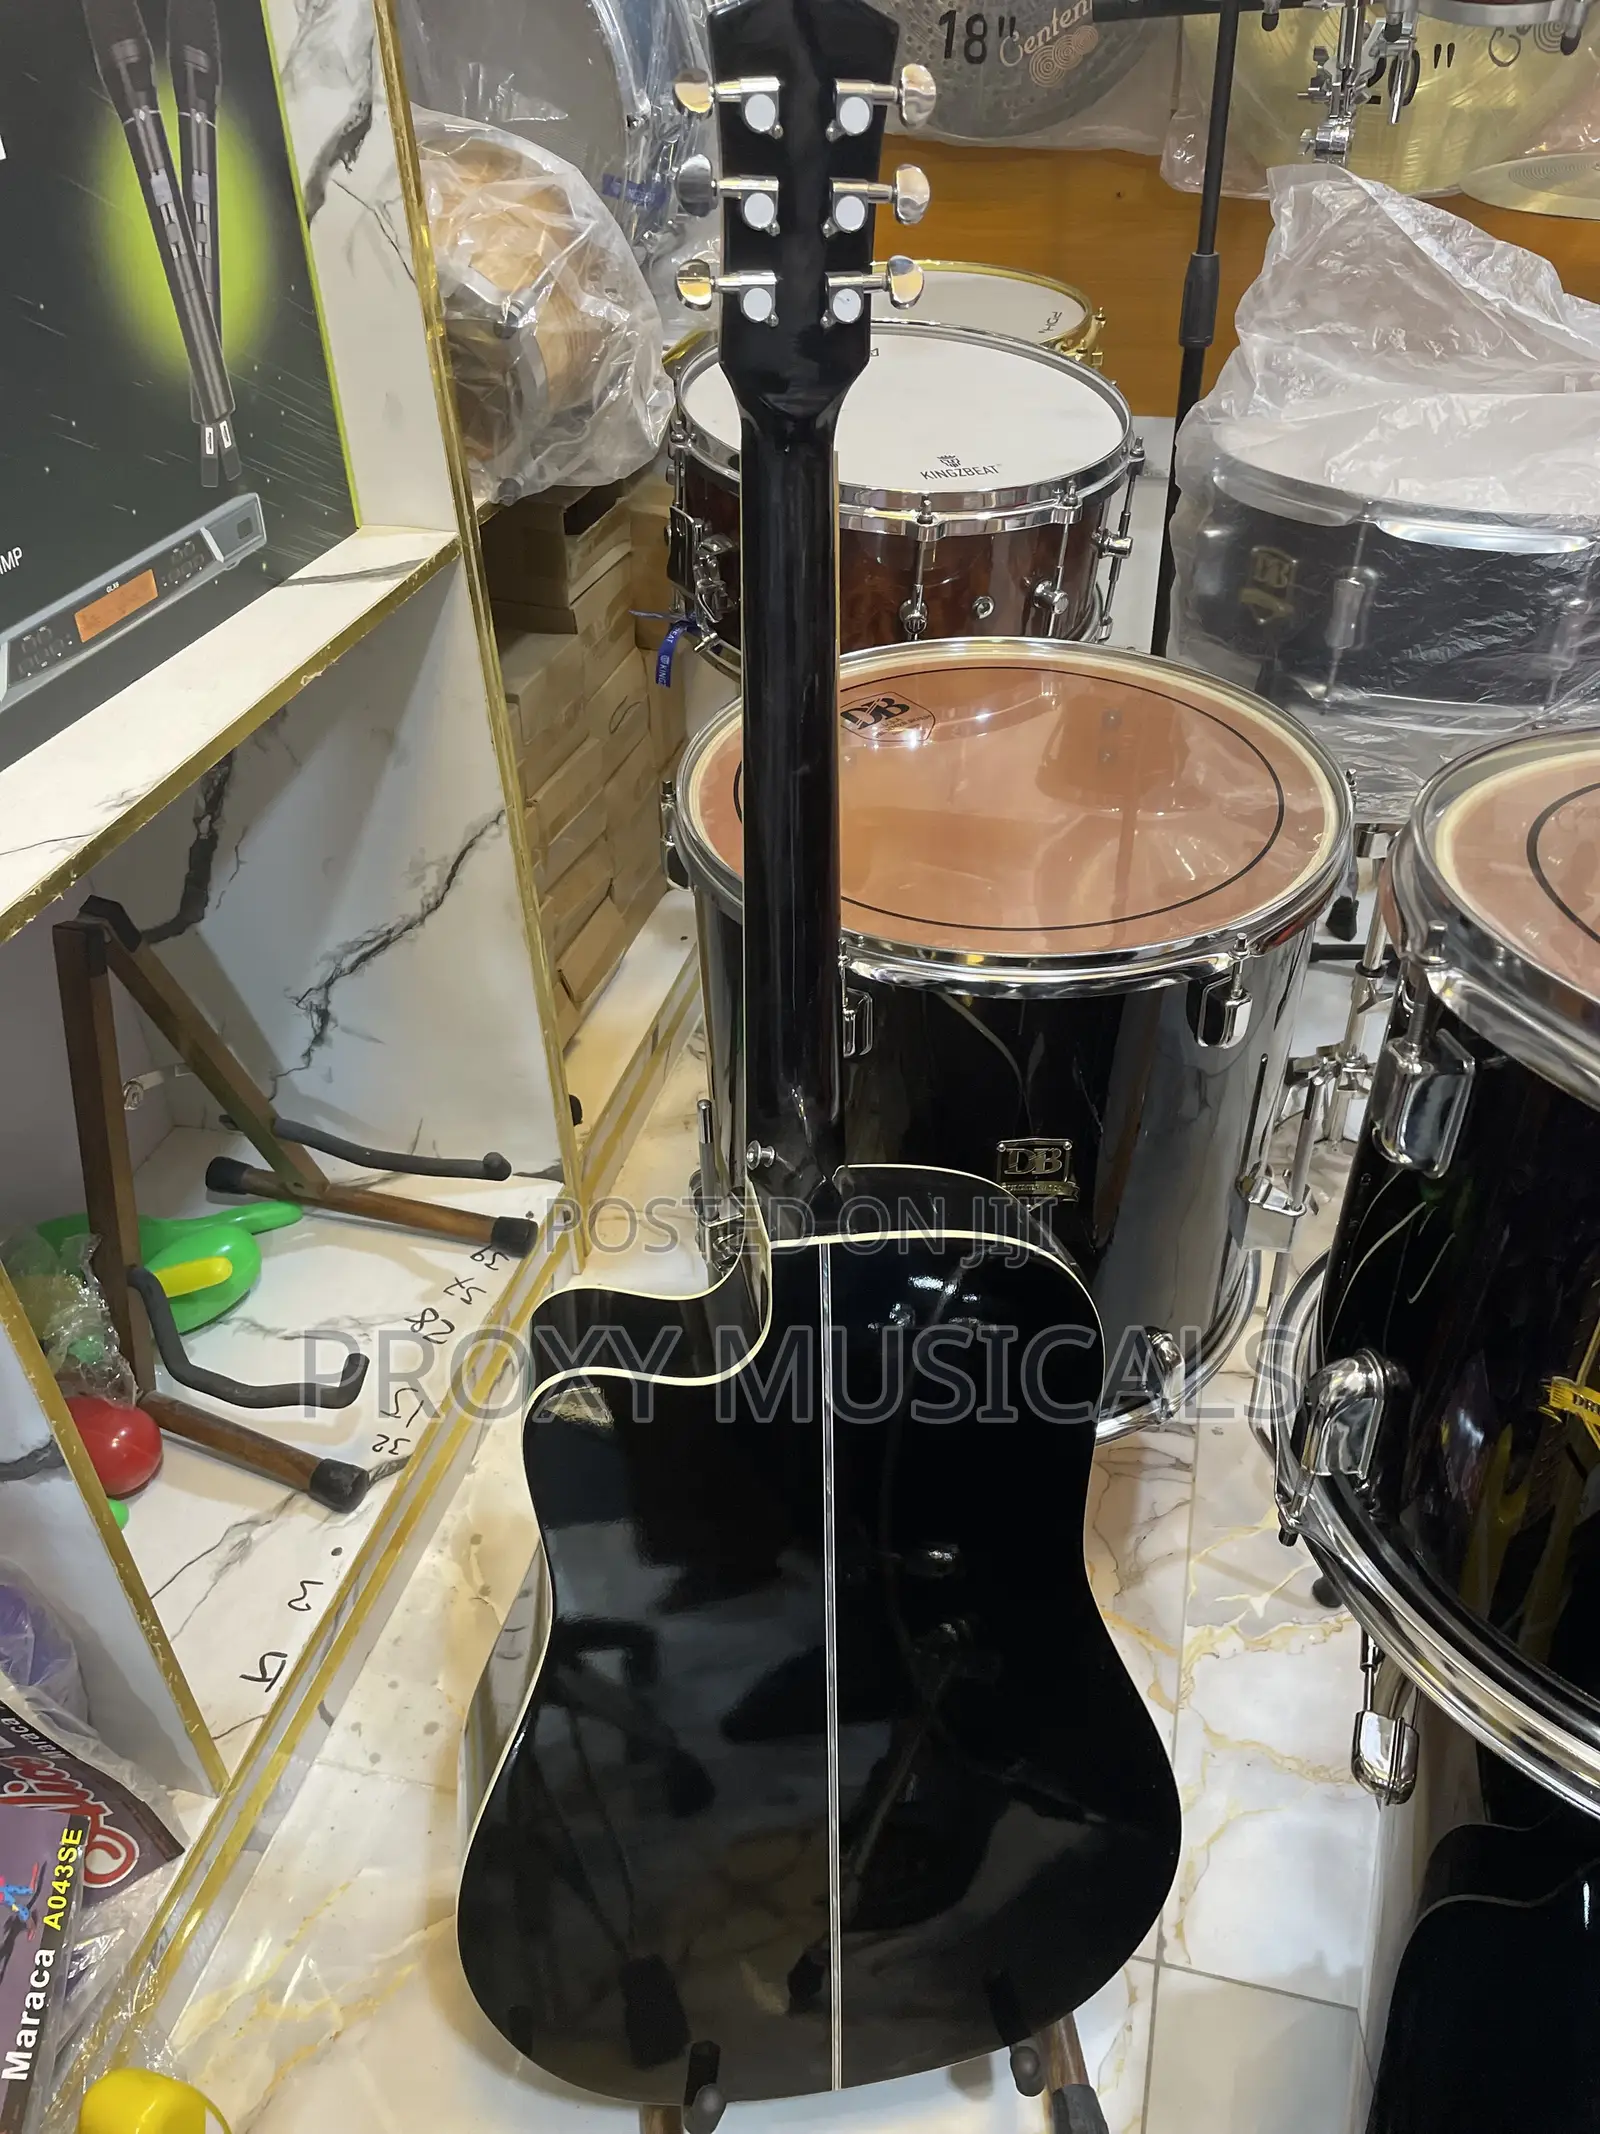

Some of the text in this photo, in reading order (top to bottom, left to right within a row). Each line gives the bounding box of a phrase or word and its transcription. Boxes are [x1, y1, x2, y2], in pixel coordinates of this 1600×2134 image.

[939, 10, 1016, 64] 18"
[920, 465, 1000, 480] KINGZBEAT
[841, 698, 909, 730] DB
[1004, 1147, 1063, 1175] DB
[404, 1307, 455, 1344] 28
[372, 1433, 411, 1455] 32
[2, 1828, 83, 2081] Maraca A043SE
